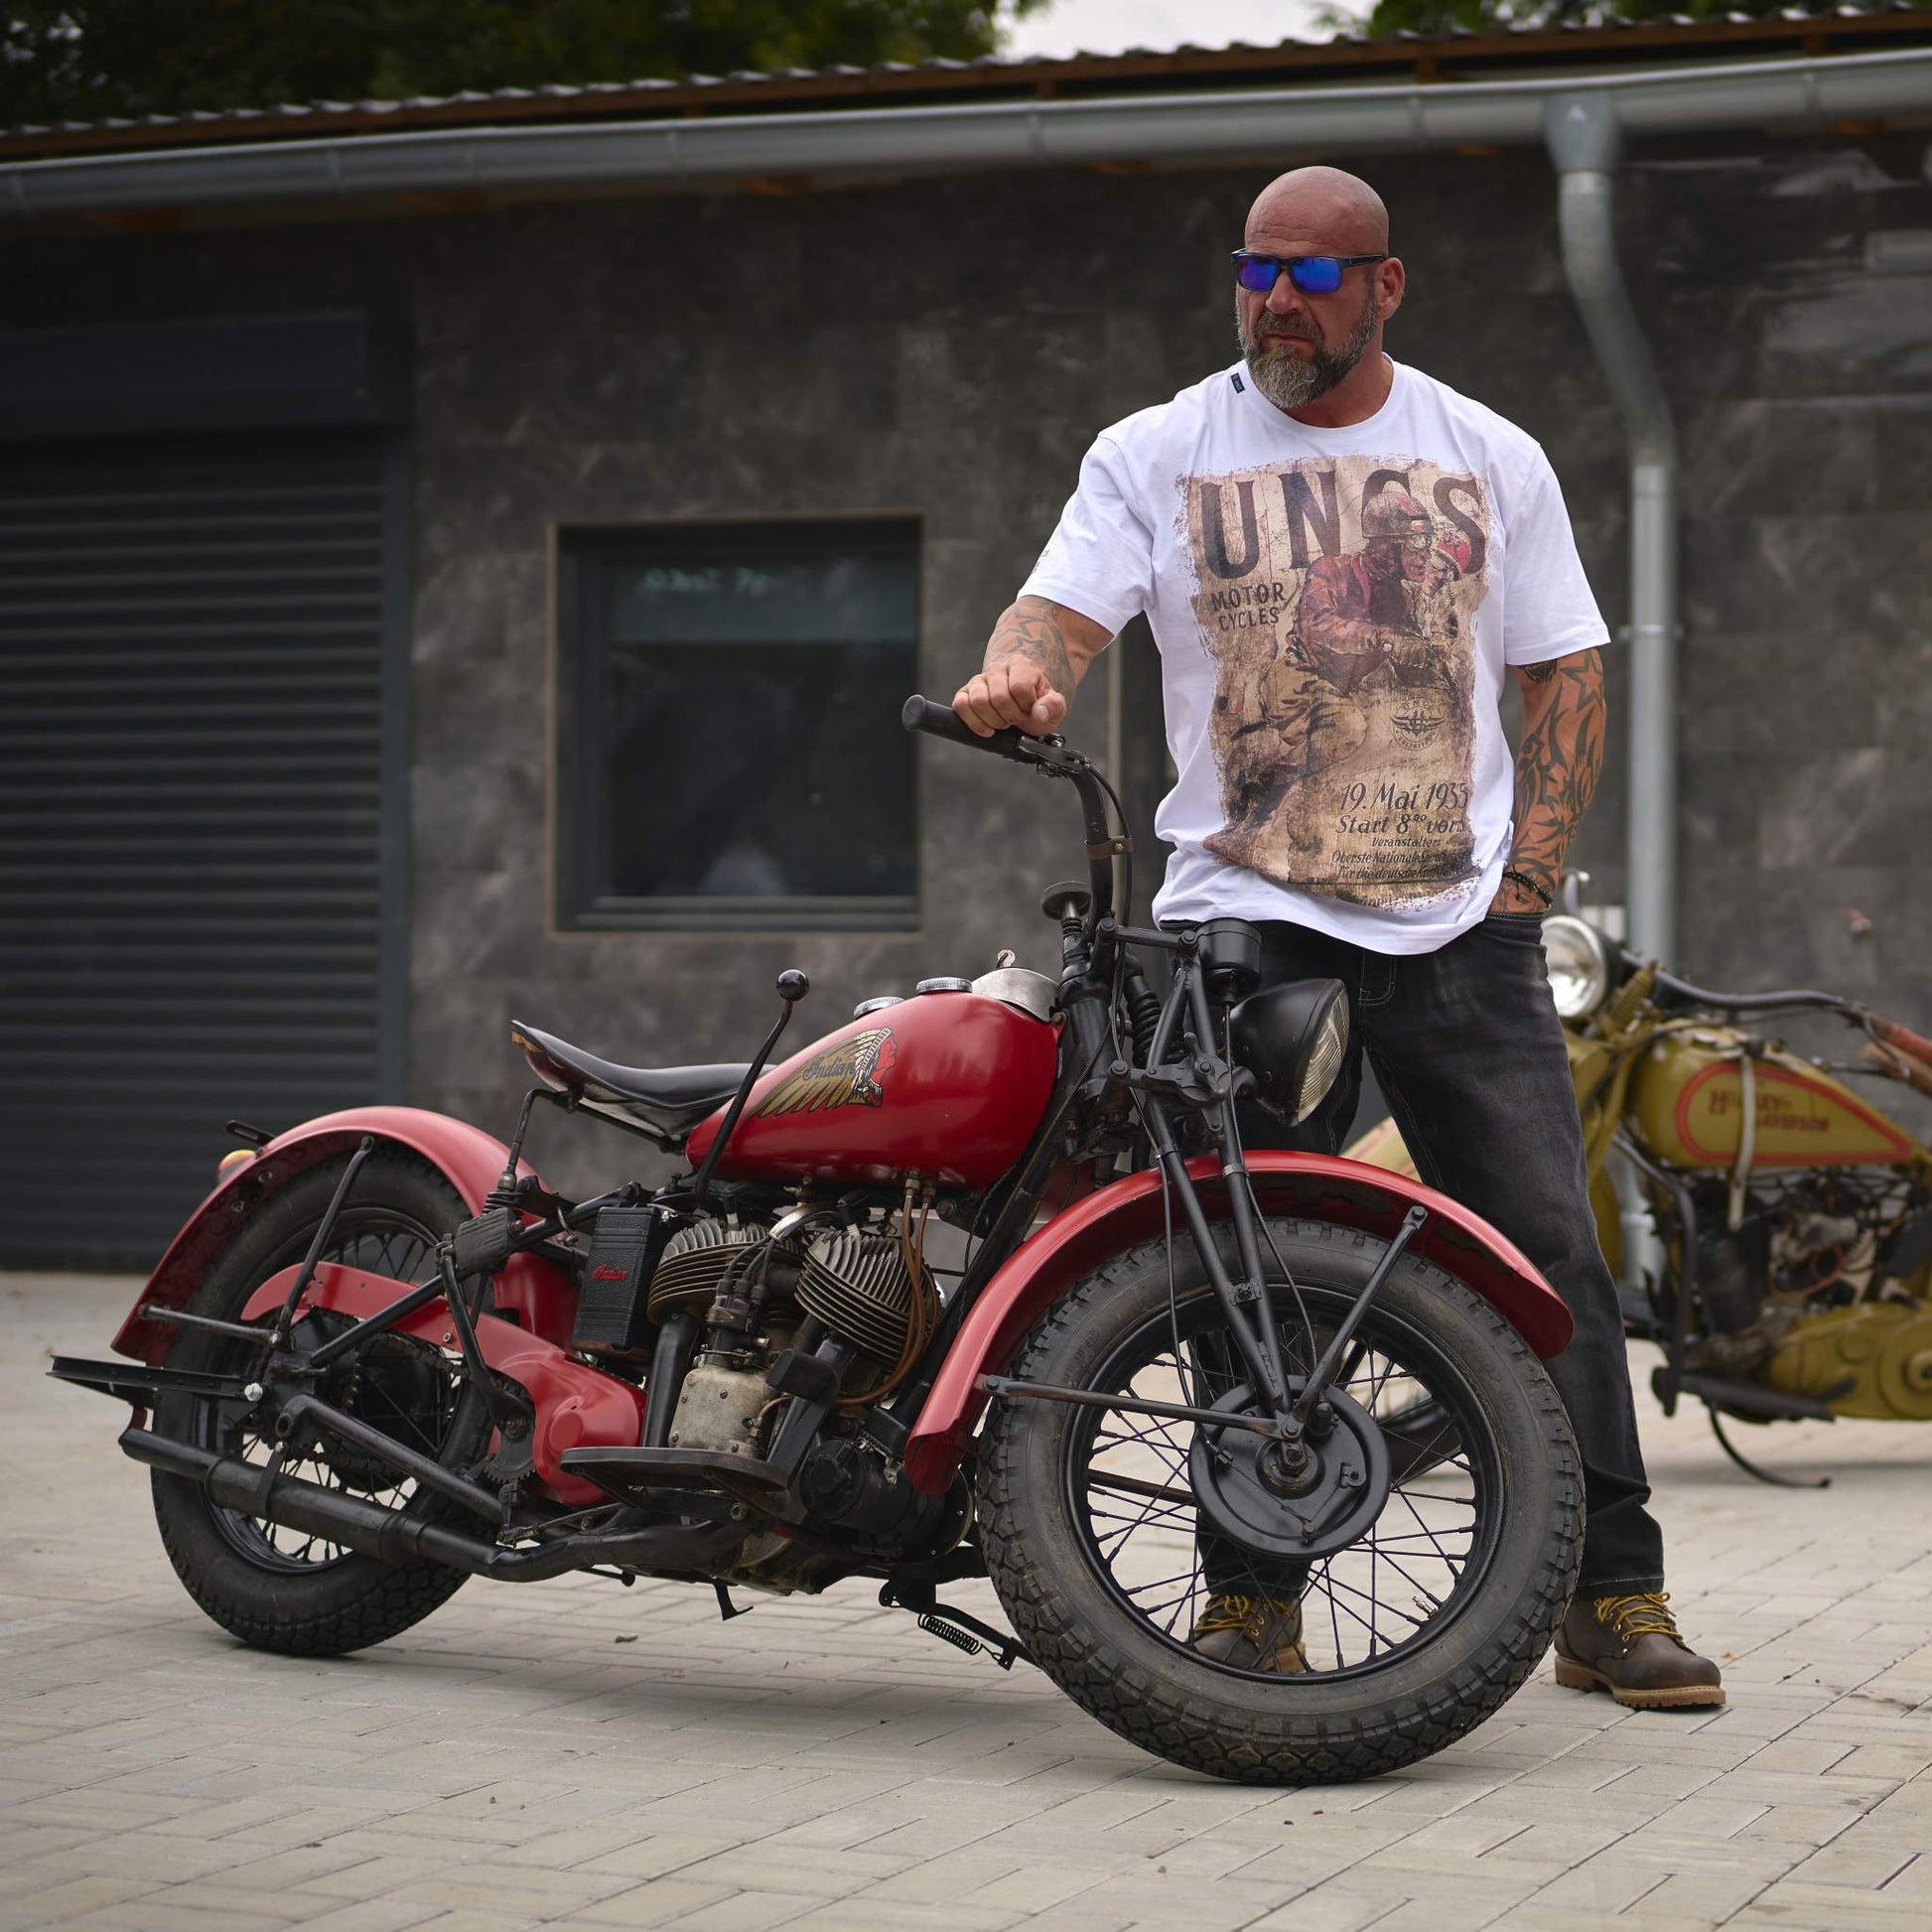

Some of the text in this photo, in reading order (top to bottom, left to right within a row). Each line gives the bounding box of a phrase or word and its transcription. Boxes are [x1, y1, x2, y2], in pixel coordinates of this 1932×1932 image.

[1210, 582, 1286, 613] MOTOR
[1218, 607, 1280, 632] CYCLES
[1340, 781, 1469, 813] 19. Mai 1935
[1335, 814, 1390, 834] Start
[1331, 849, 1372, 864] Oberste
[802, 1055, 857, 1082] Indian
